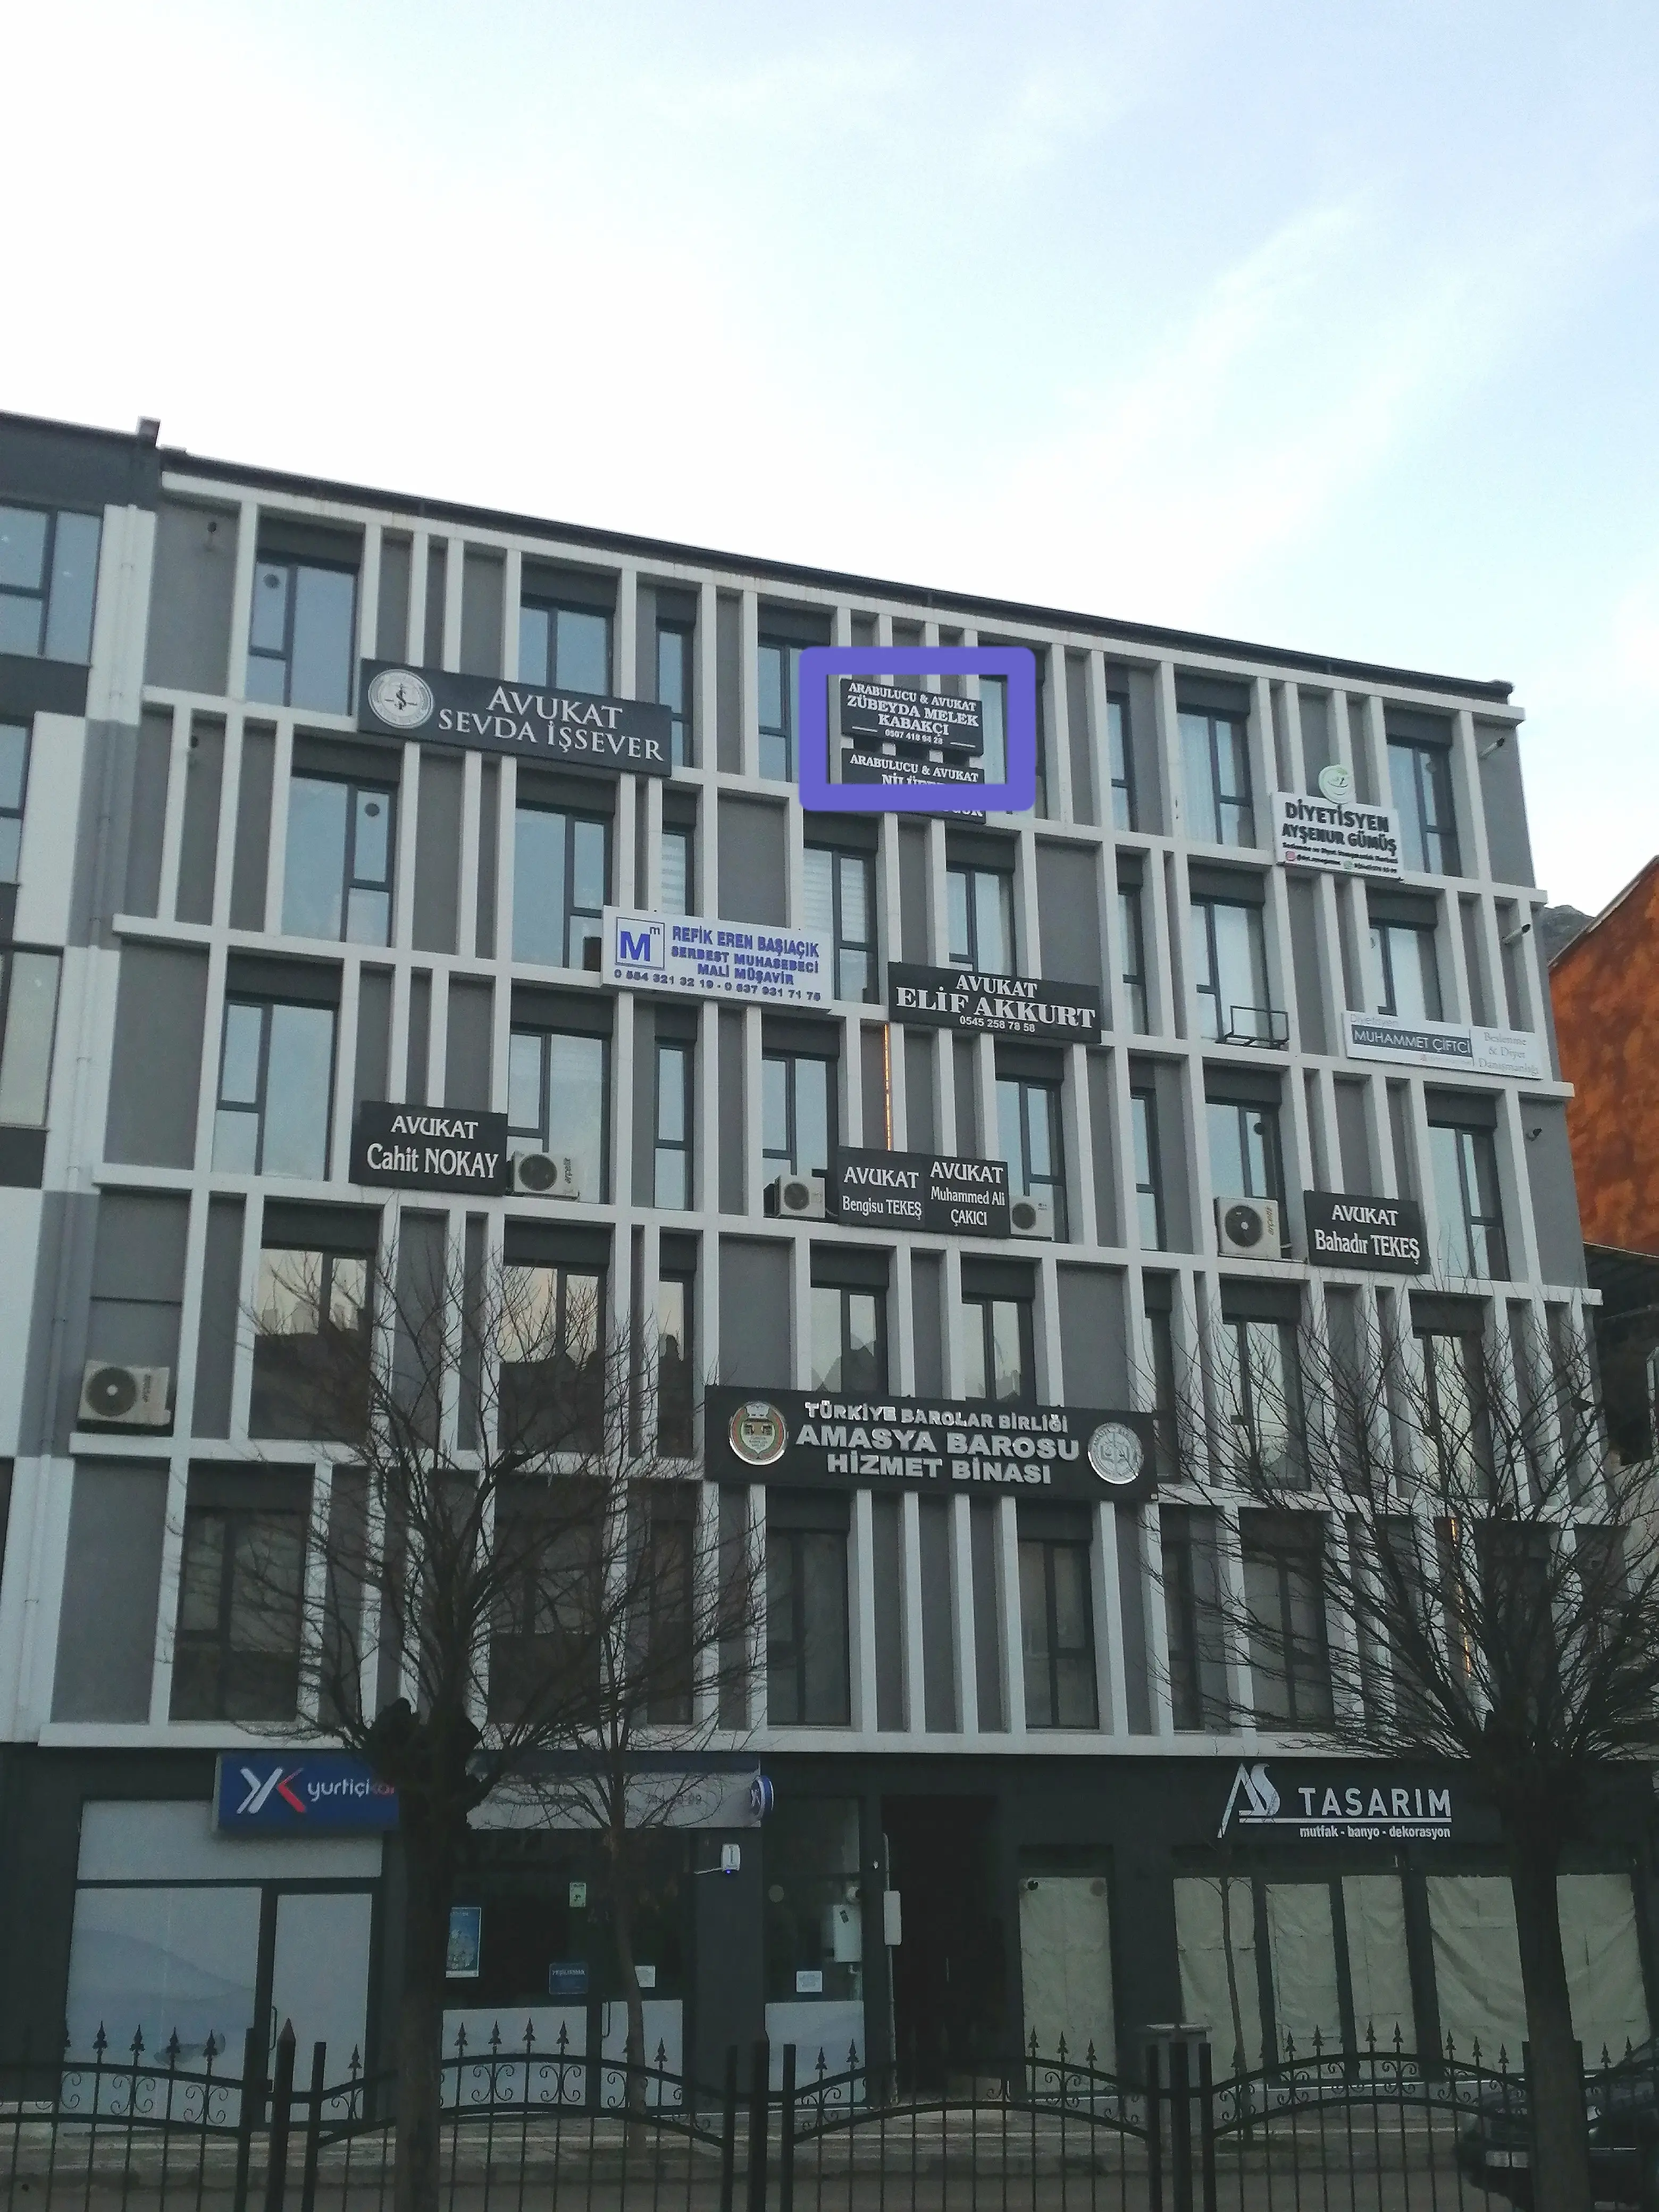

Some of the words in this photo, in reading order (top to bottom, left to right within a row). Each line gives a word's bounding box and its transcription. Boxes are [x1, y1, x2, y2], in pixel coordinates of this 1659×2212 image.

[487, 685, 623, 730] AVUKAT
[847, 694, 920, 718] ZÜBEYDA
[924, 708, 978, 727] MELEK
[849, 682, 916, 702] ARABULUCU
[920, 695, 929, 703] &
[932, 696, 977, 712] AVUKAT
[438, 709, 538, 744] SEVDA
[548, 721, 665, 762] İŞSEVER
[878, 714, 949, 737] KABAKÇI
[850, 754, 918, 774] ARABULUCU
[921, 766, 931, 775] &
[933, 767, 978, 783] AVUKAT
[1285, 799, 1389, 833] DİYETİSYEN
[1282, 824, 1345, 844] AYŞENUR
[672, 926, 713, 945] REFİK
[717, 931, 752, 949] EREN
[671, 945, 729, 964] SERBEST
[734, 954, 818, 974] MUHASEBECİ
[698, 963, 730, 978] MALİ
[734, 968, 794, 985] MÜŞAVİR
[957, 975, 1037, 998] AVUKAT
[896, 986, 968, 1013] ELİF
[973, 997, 1095, 1028] AKKURT
[1354, 1030, 1429, 1048] MUHAMMET
[390, 1116, 479, 1139] AVUKAT
[367, 1143, 420, 1172] Cahit
[424, 1147, 499, 1179] NOKAY
[930, 1161, 1004, 1184] AVUKAT
[844, 1167, 919, 1189] AVUKAT
[842, 1195, 884, 1217] Bengisu
[886, 1200, 922, 1221] TEKEŞ
[931, 1186, 989, 1205] Muhammed
[991, 1192, 1006, 1206] Ali
[951, 1209, 987, 1226] ÇAKICI
[1331, 1204, 1400, 1226] AVUKAT
[1314, 1229, 1369, 1254] Bahadır
[1370, 1235, 1421, 1265] TEKEŞ
[804, 1400, 896, 1422] TÜRKİYE
[901, 1408, 994, 1429] BAROLAR
[999, 1411, 1068, 1433] BİRLİĞİ
[796, 1424, 937, 1453] AMASYA
[946, 1432, 1079, 1462] BAROSU
[827, 1448, 942, 1479] HİZMET
[951, 1457, 1051, 1485] BİNASI
[1298, 1787, 1452, 1817] TASARIM
[1300, 1825, 1339, 1838] mutfak
[1347, 1824, 1380, 1840] banyo
[1389, 1825, 1451, 1840] dekorasyon
